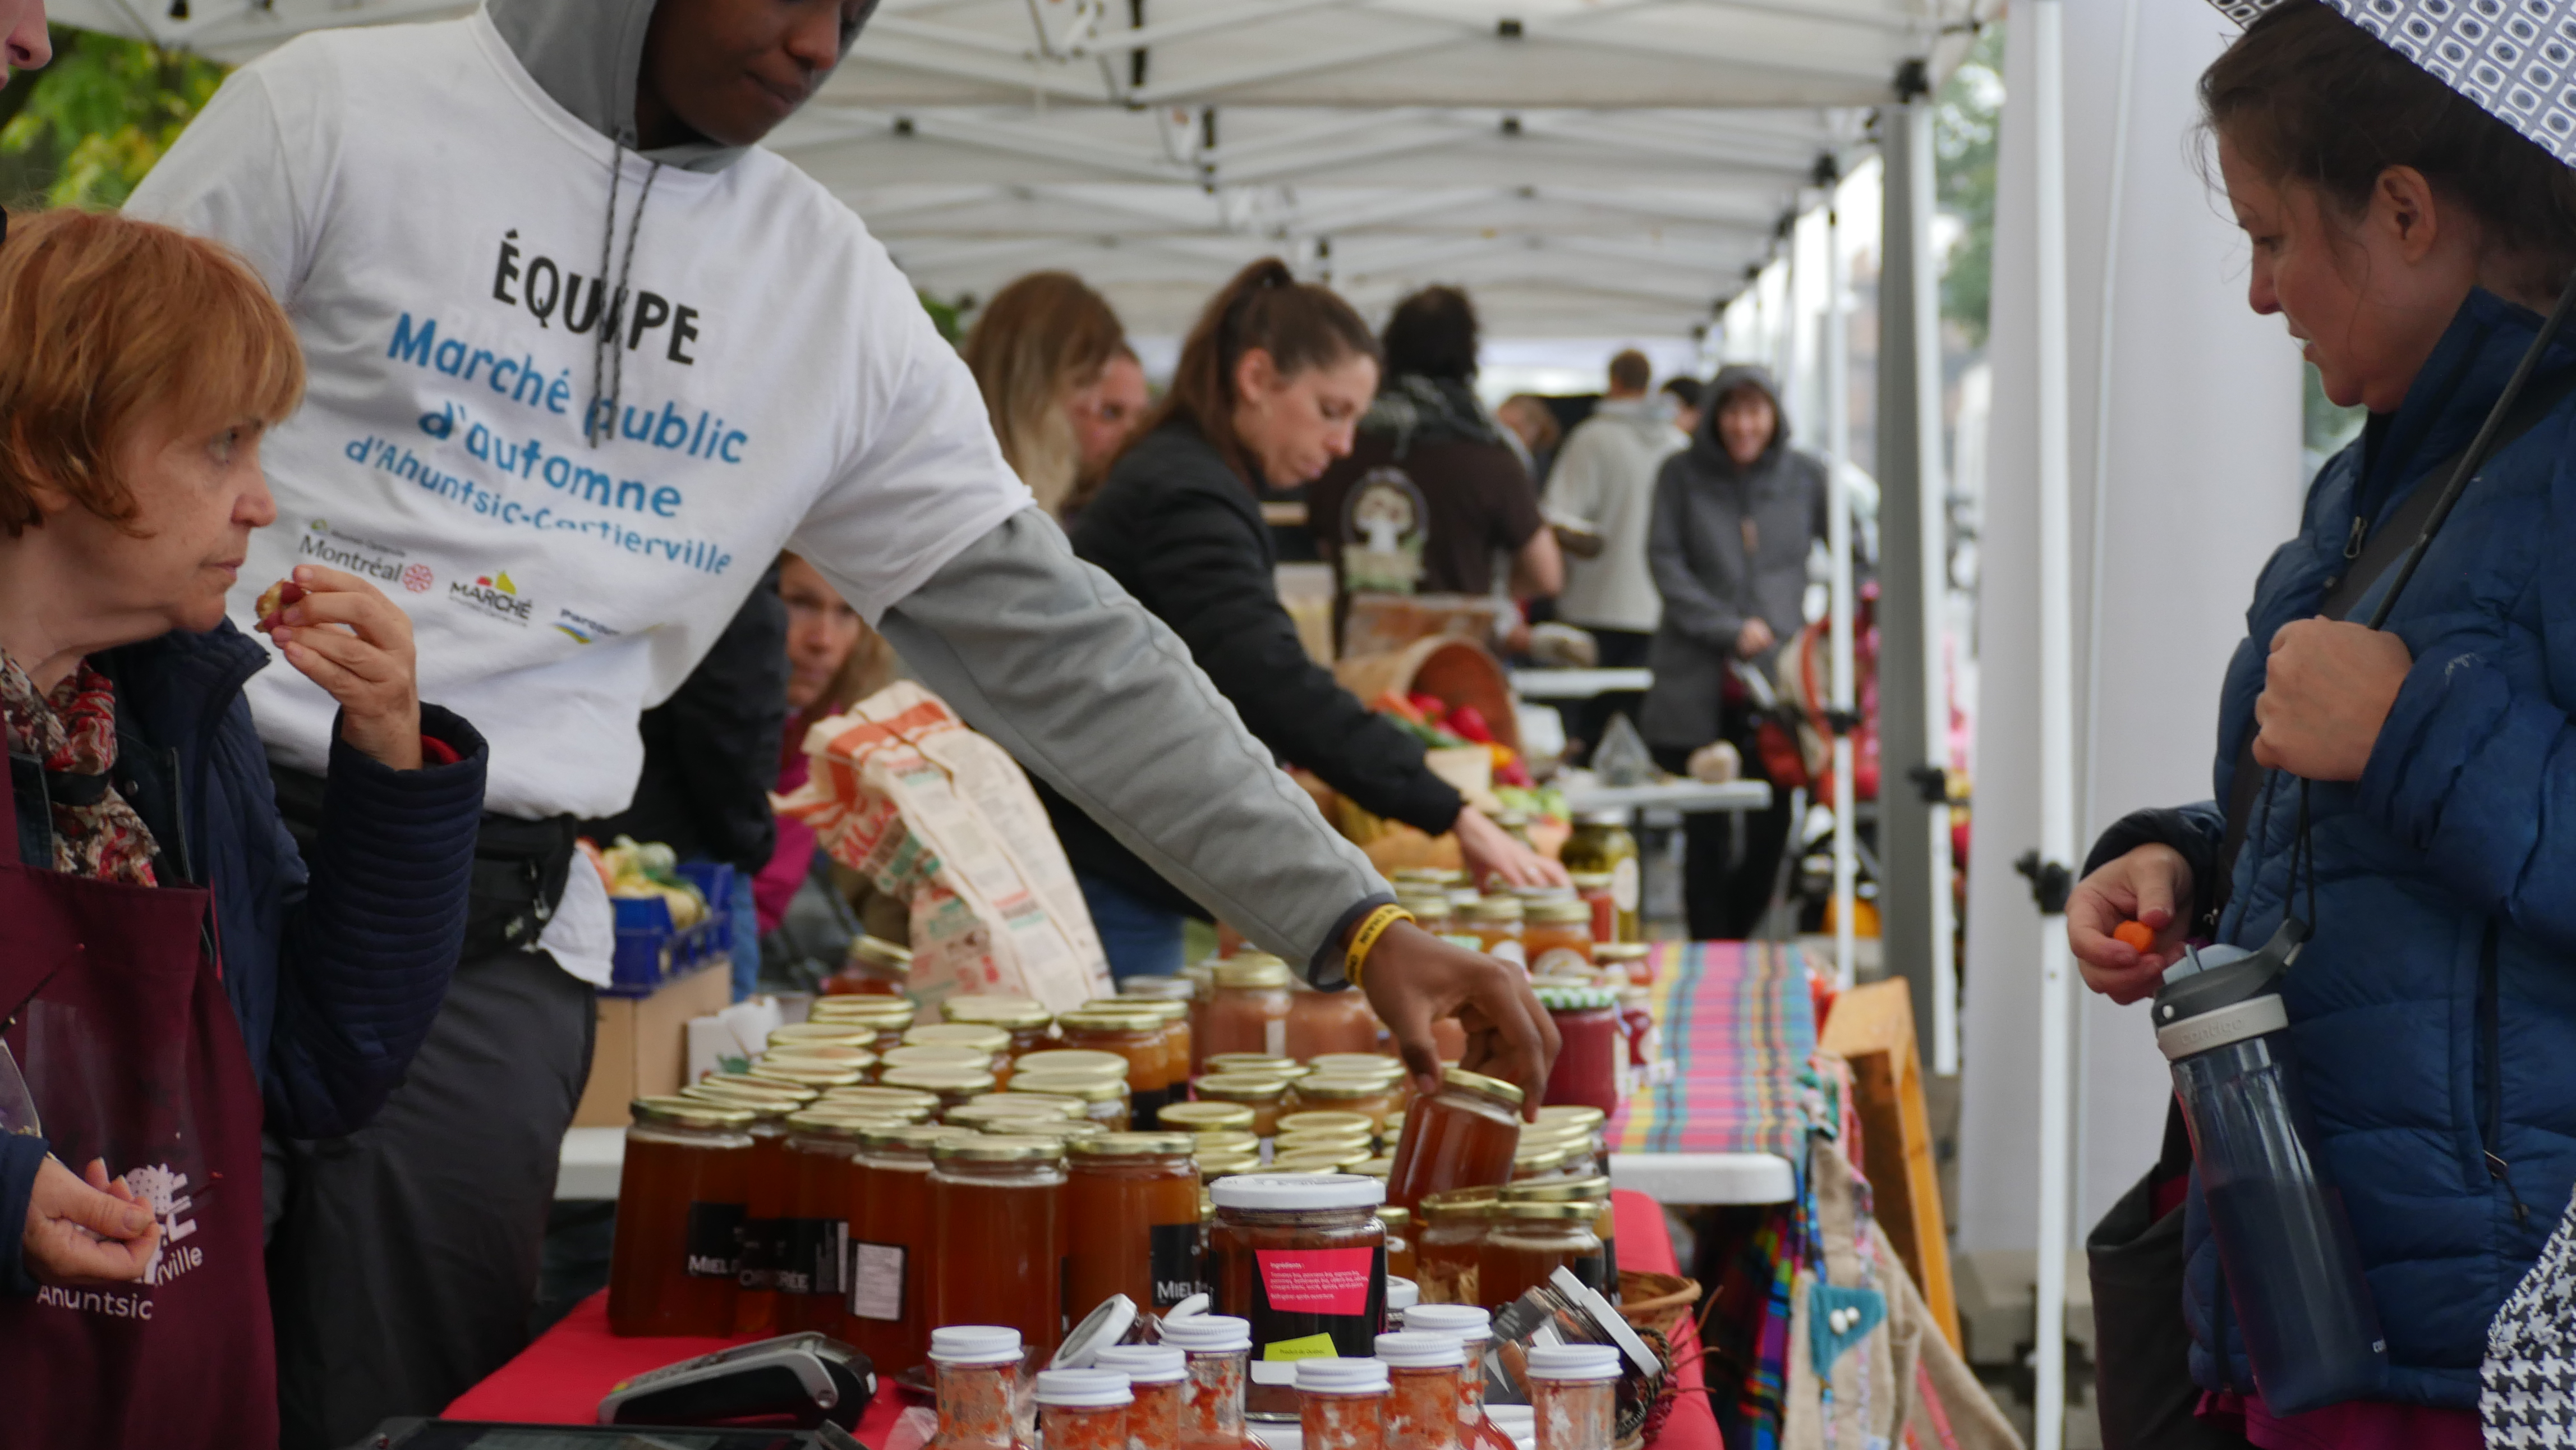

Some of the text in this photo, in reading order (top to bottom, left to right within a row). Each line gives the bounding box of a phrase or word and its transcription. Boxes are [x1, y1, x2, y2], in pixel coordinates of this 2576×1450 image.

[493, 228, 699, 365] ÉQUIPE
[387, 313, 747, 464] Marché public
[418, 401, 682, 518] d'automne
[298, 535, 403, 582] Montréal
